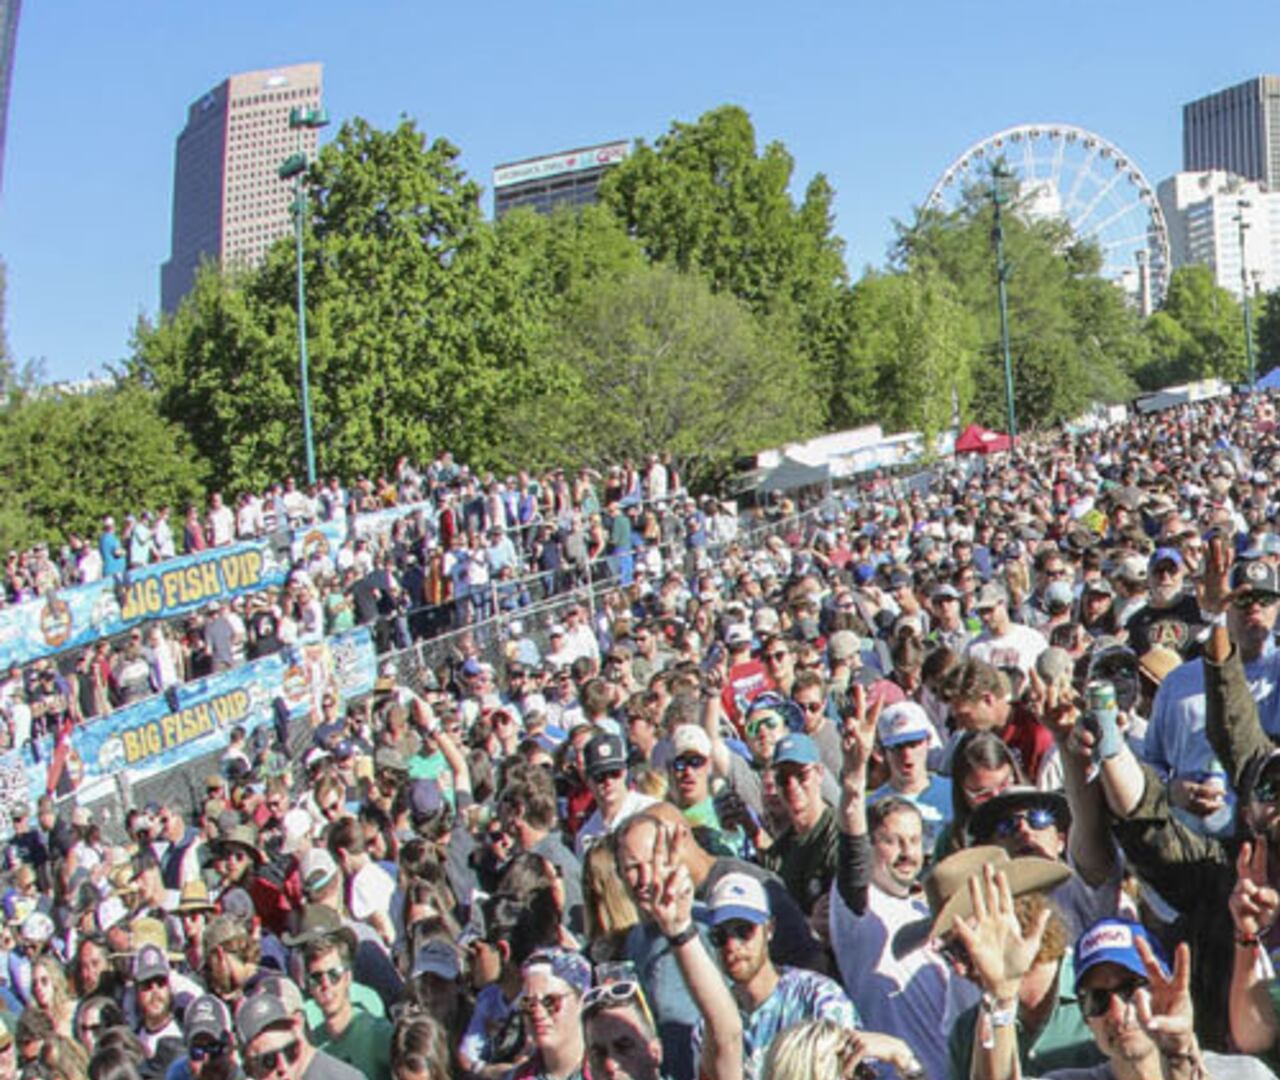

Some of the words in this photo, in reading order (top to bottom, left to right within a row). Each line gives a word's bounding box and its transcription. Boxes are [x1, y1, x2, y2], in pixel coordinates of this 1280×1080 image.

[162, 560, 220, 607] FISH
[220, 552, 261, 589] VIP
[122, 723, 161, 763] BIG
[160, 703, 213, 748] FISH
[212, 689, 249, 725] VIP
